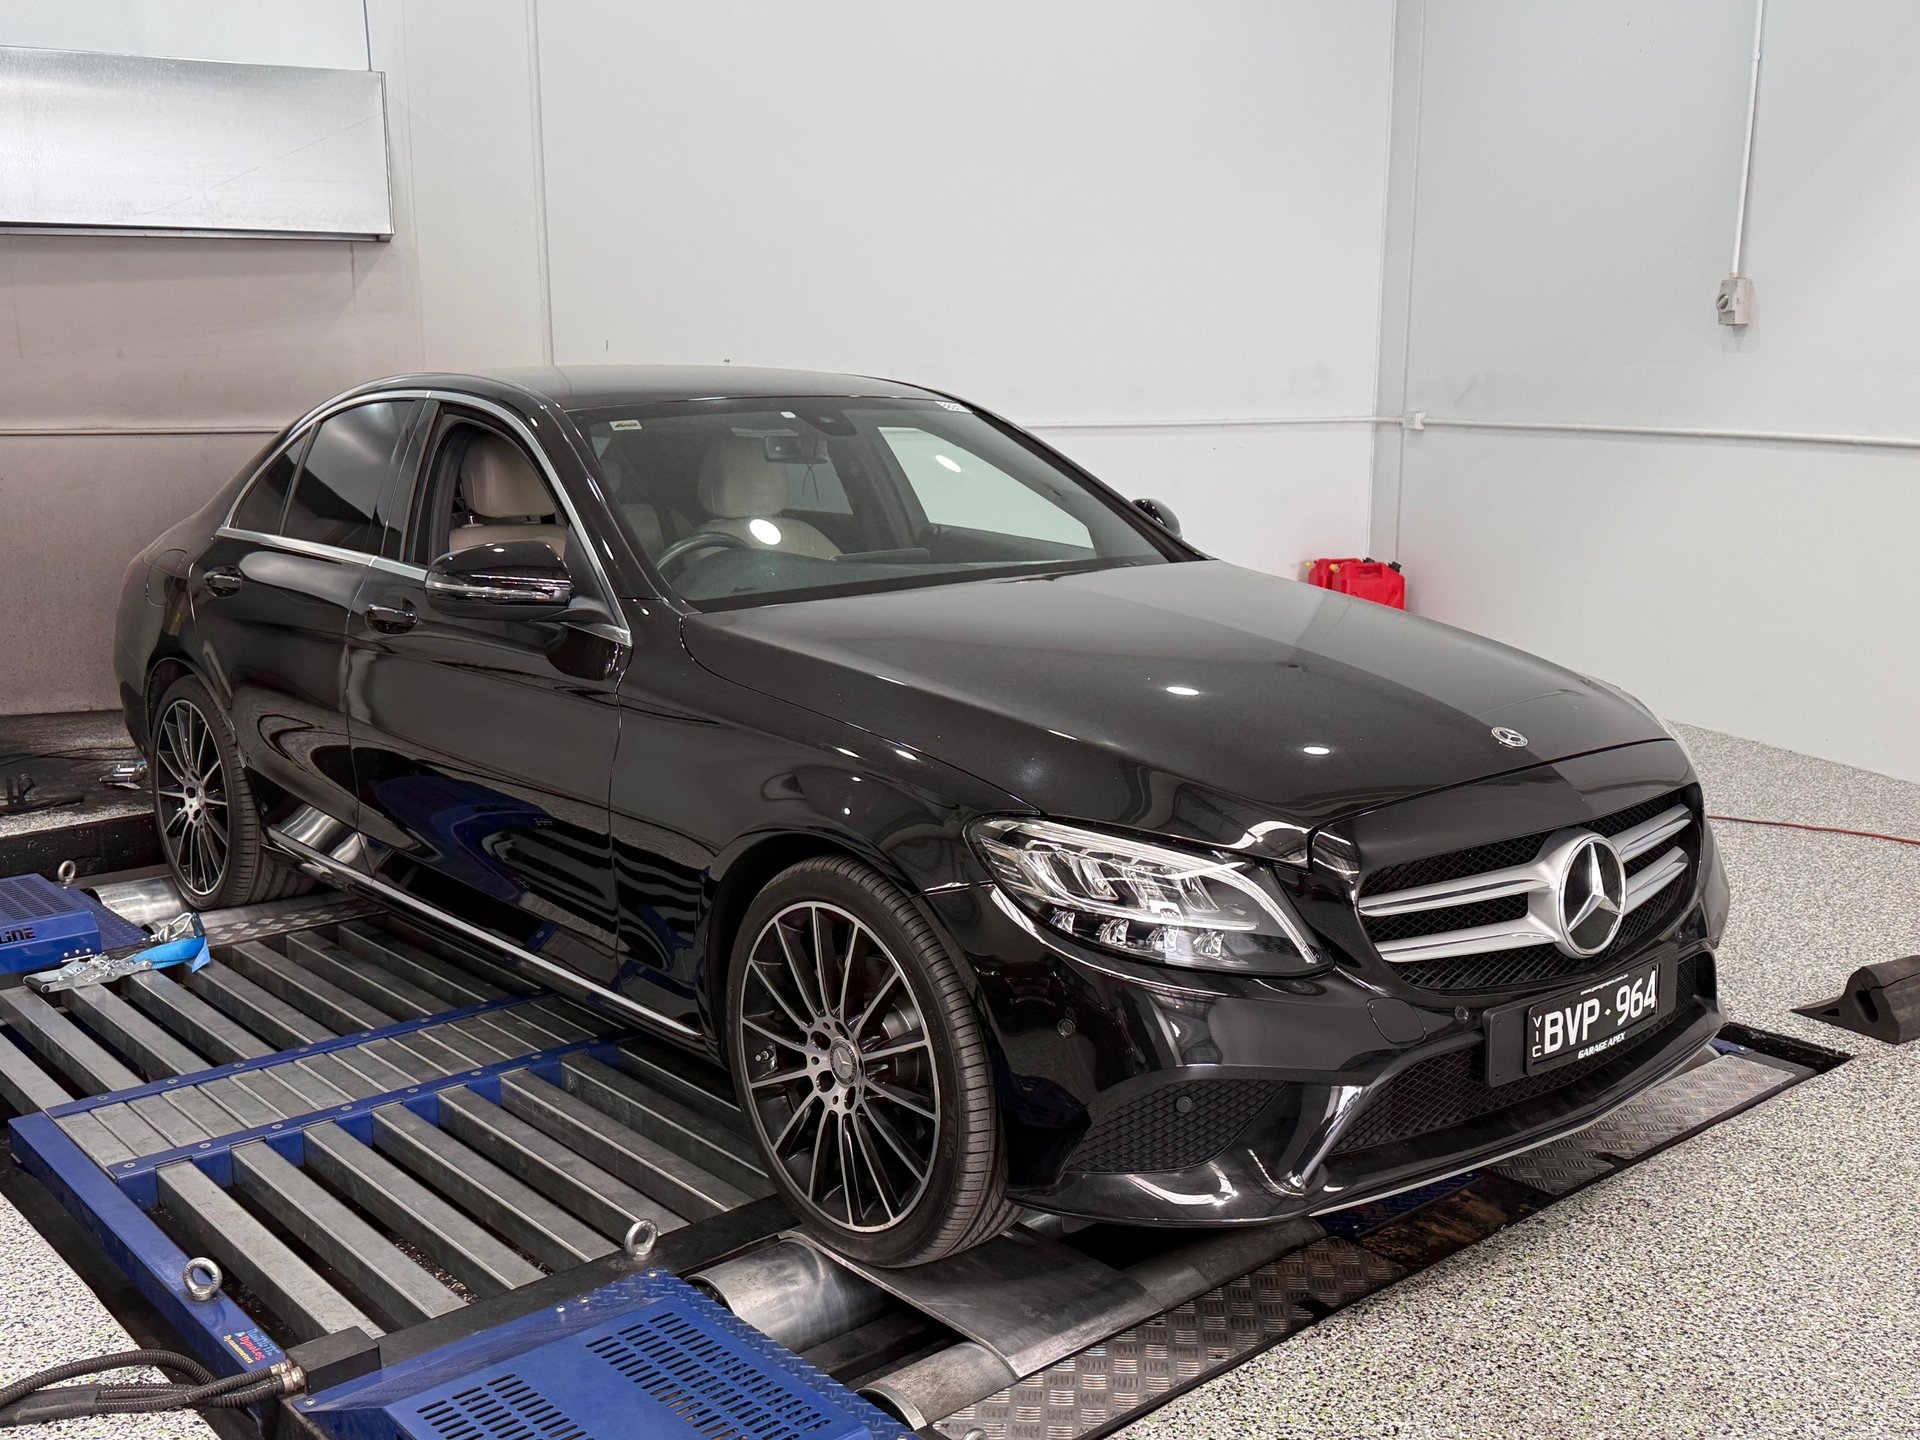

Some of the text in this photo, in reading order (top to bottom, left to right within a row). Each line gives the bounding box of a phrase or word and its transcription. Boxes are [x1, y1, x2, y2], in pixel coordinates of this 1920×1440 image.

[1544, 970, 1656, 1055] BVP 964
[1532, 1015, 1542, 1057] VIC
[1577, 1031, 1626, 1060] GARAGE APEX
